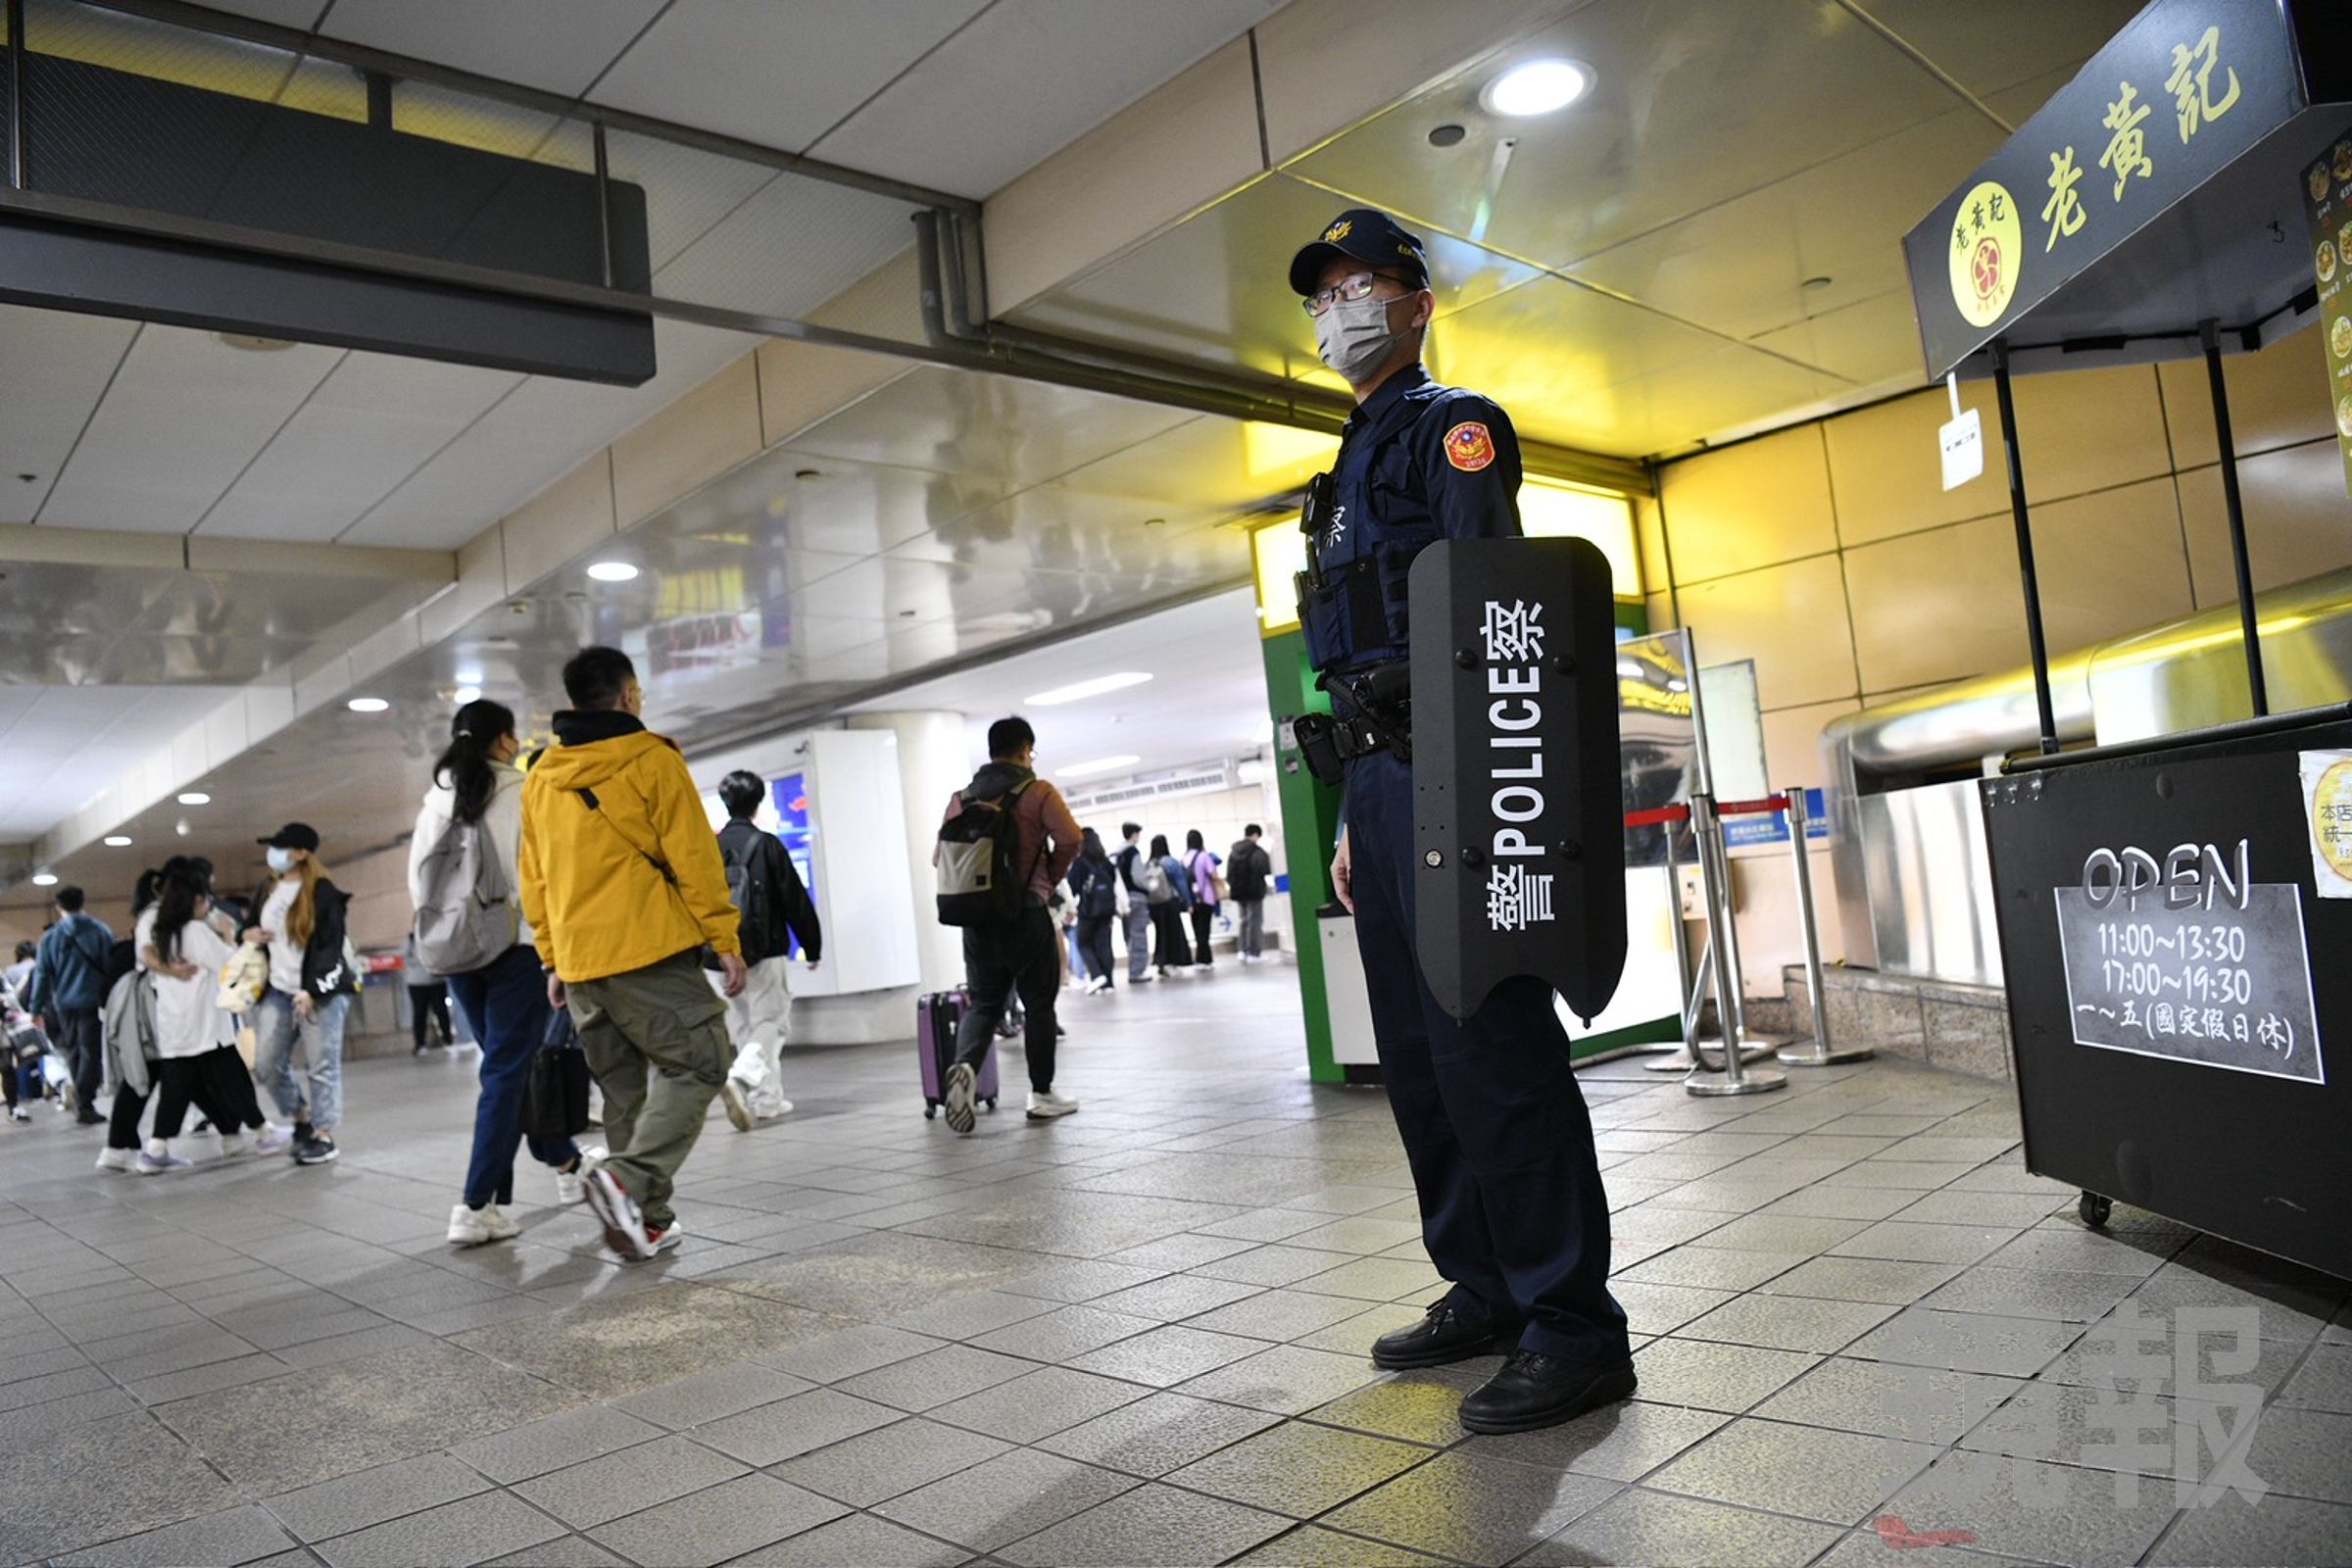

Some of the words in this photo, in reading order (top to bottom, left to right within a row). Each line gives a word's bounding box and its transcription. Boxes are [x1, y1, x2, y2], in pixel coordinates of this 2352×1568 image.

[2041, 25, 2241, 253] 老黃記
[1955, 192, 2006, 255] 老黃記
[2082, 839, 2249, 912] OPEN
[2098, 923, 2246, 963] 11:00~13:30
[2102, 959, 2252, 1005] 17:00~19:30
